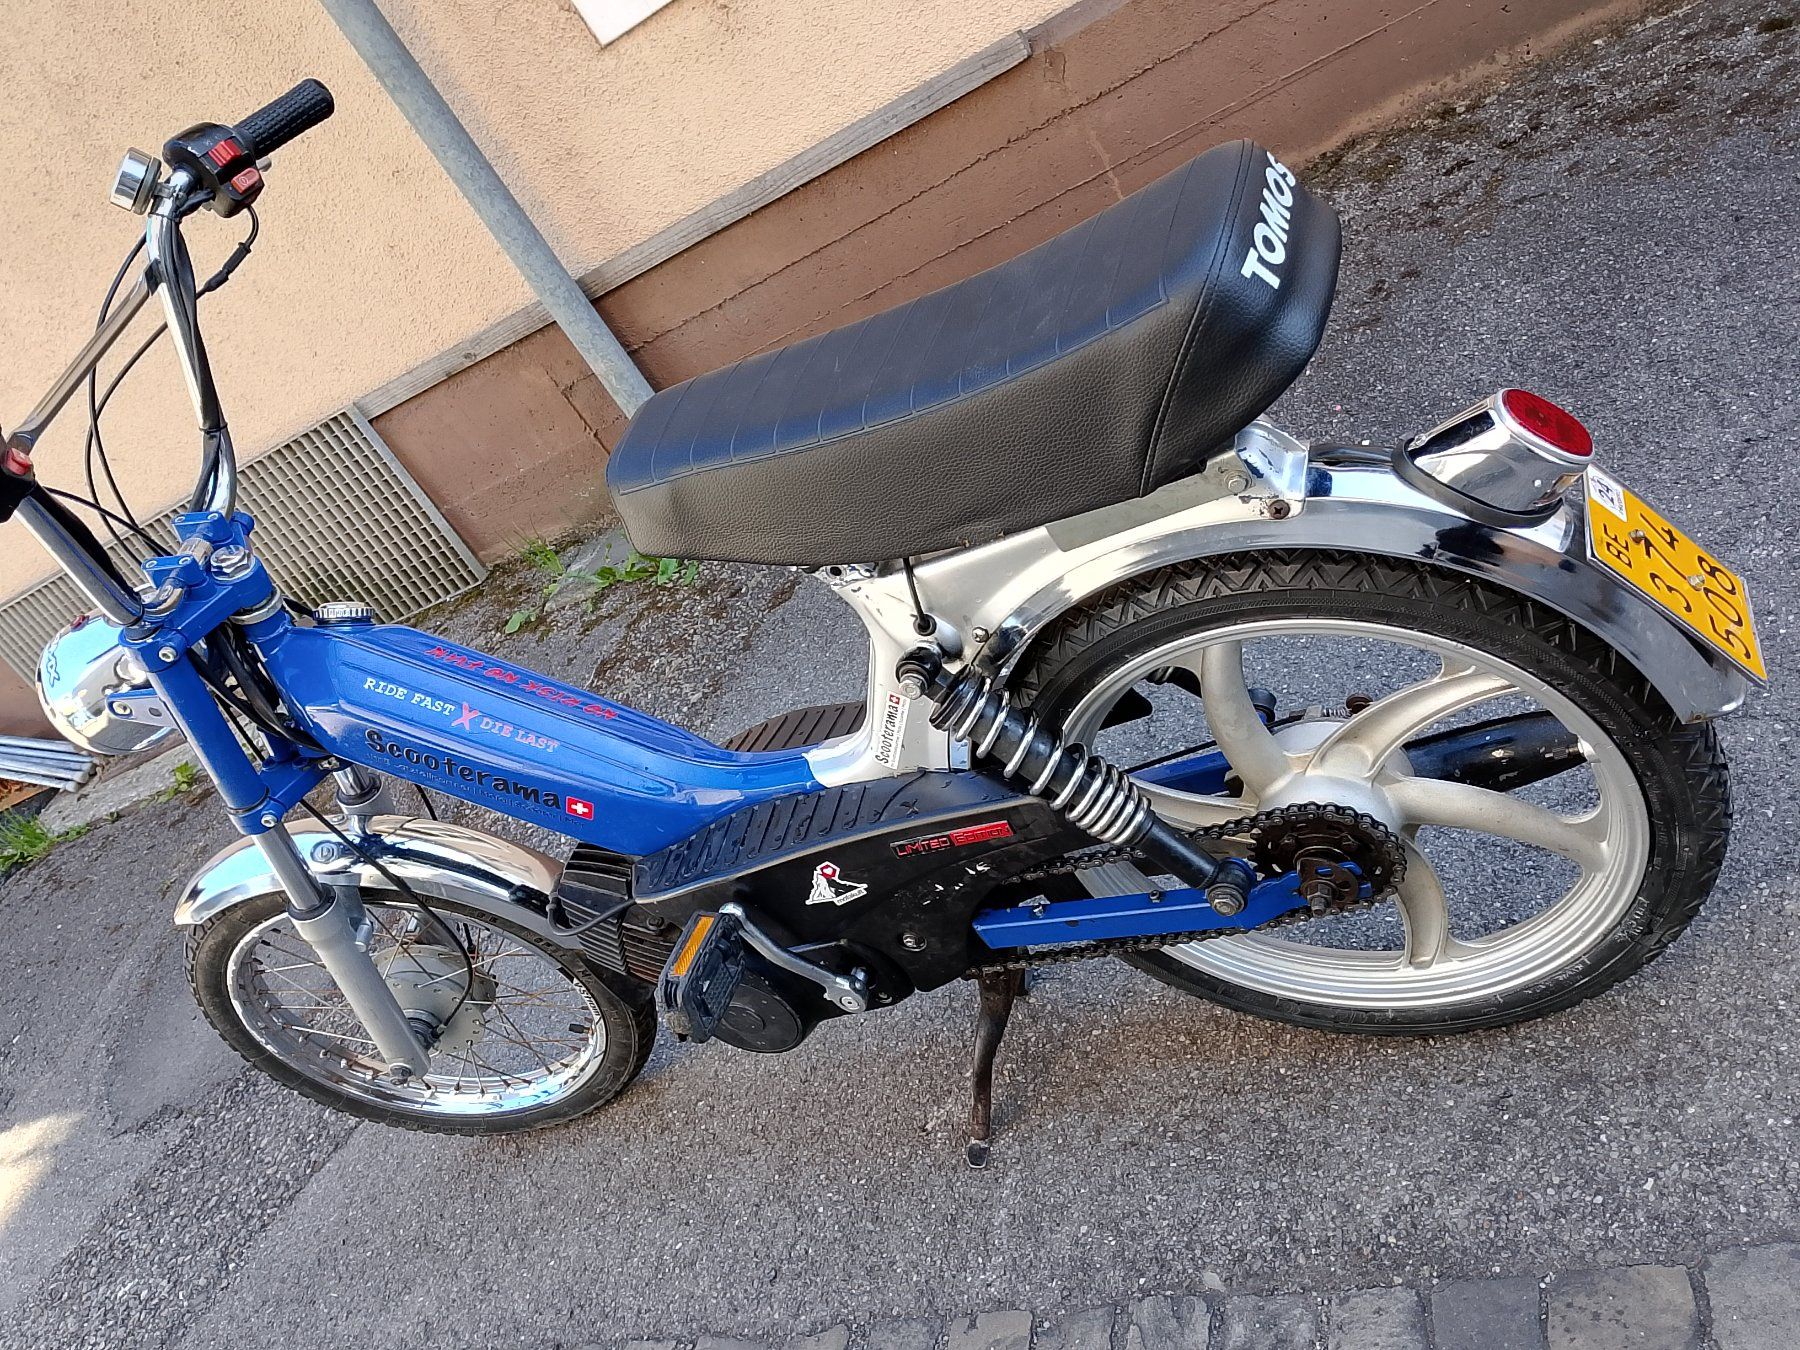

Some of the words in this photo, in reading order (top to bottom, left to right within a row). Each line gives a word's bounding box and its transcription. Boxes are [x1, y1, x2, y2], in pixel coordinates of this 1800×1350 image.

[1241, 151, 1296, 290] TOMOS
[1603, 522, 1633, 570] BE
[1697, 555, 1752, 660] 508
[363, 677, 408, 700] RIDE
[410, 691, 456, 716] FAST
[480, 716, 513, 738] DIE
[516, 729, 561, 753] LAST
[875, 704, 899, 764] Scooterama
[364, 729, 562, 810] Scooterama
[896, 837, 951, 856] LIMITED
[954, 825, 1010, 844] EDITION
